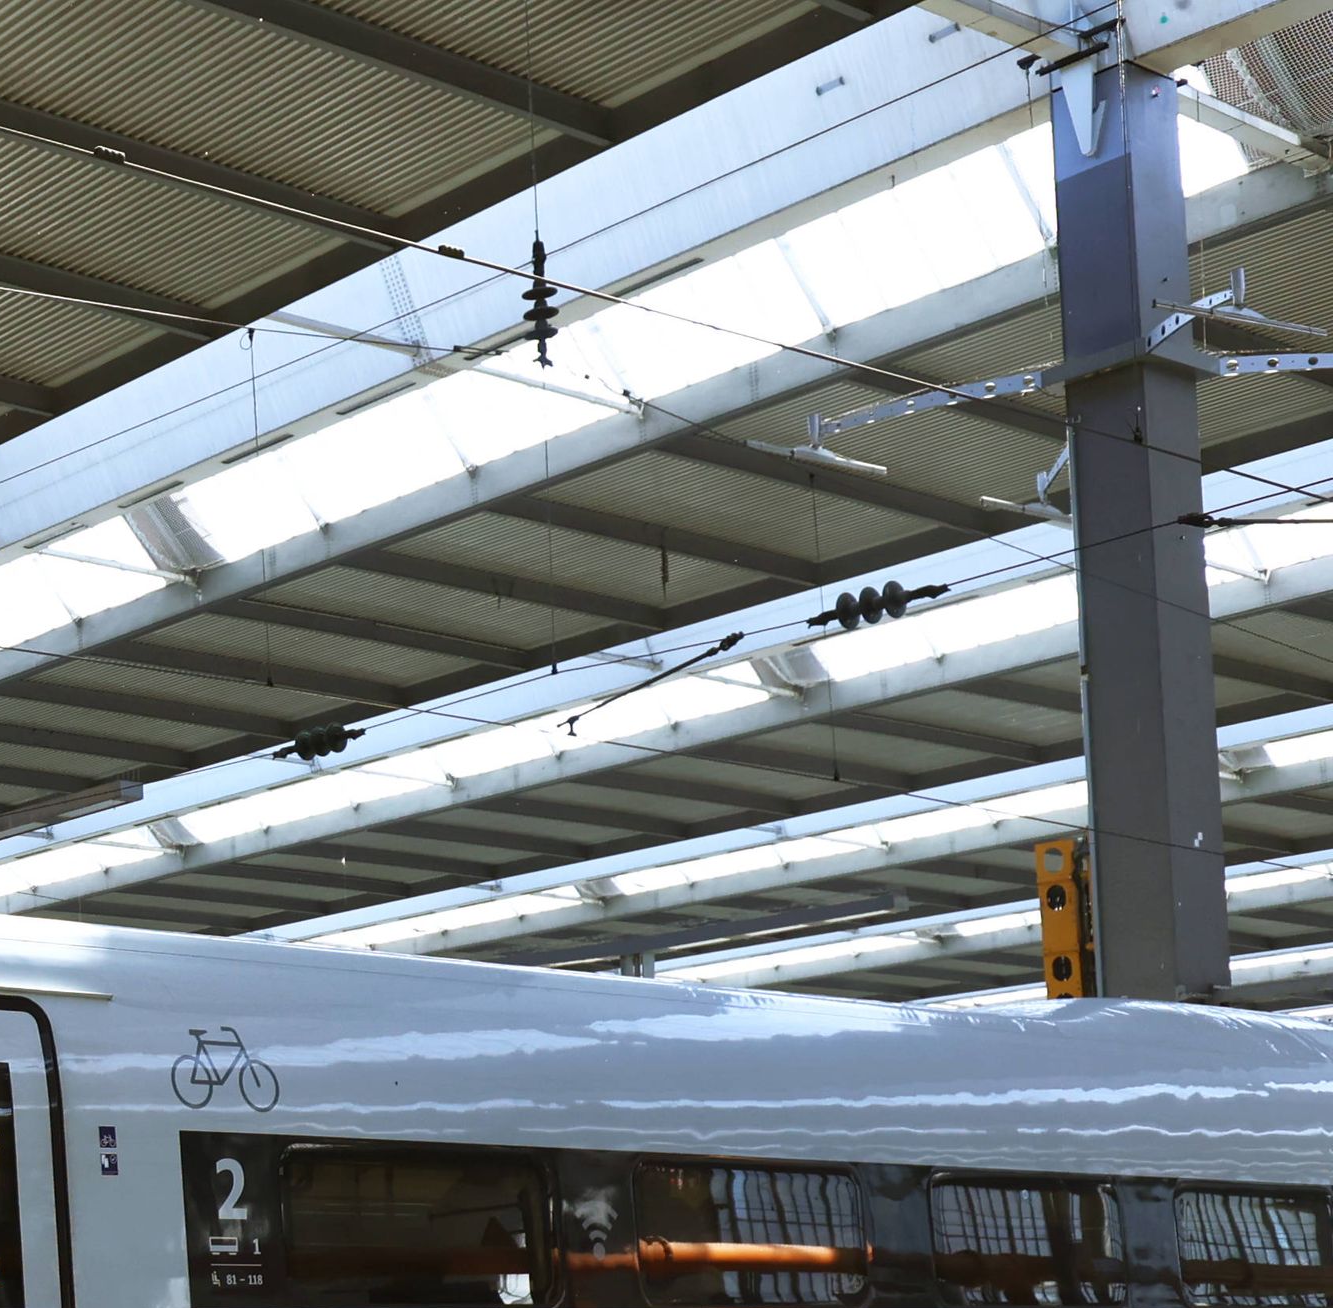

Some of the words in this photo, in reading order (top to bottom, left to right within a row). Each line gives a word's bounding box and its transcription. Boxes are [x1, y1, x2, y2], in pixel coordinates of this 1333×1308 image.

[216, 1157, 248, 1220] 2
[253, 1238, 262, 1255] 1
[226, 1274, 237, 1285] 81
[248, 1274, 263, 1285] 118
